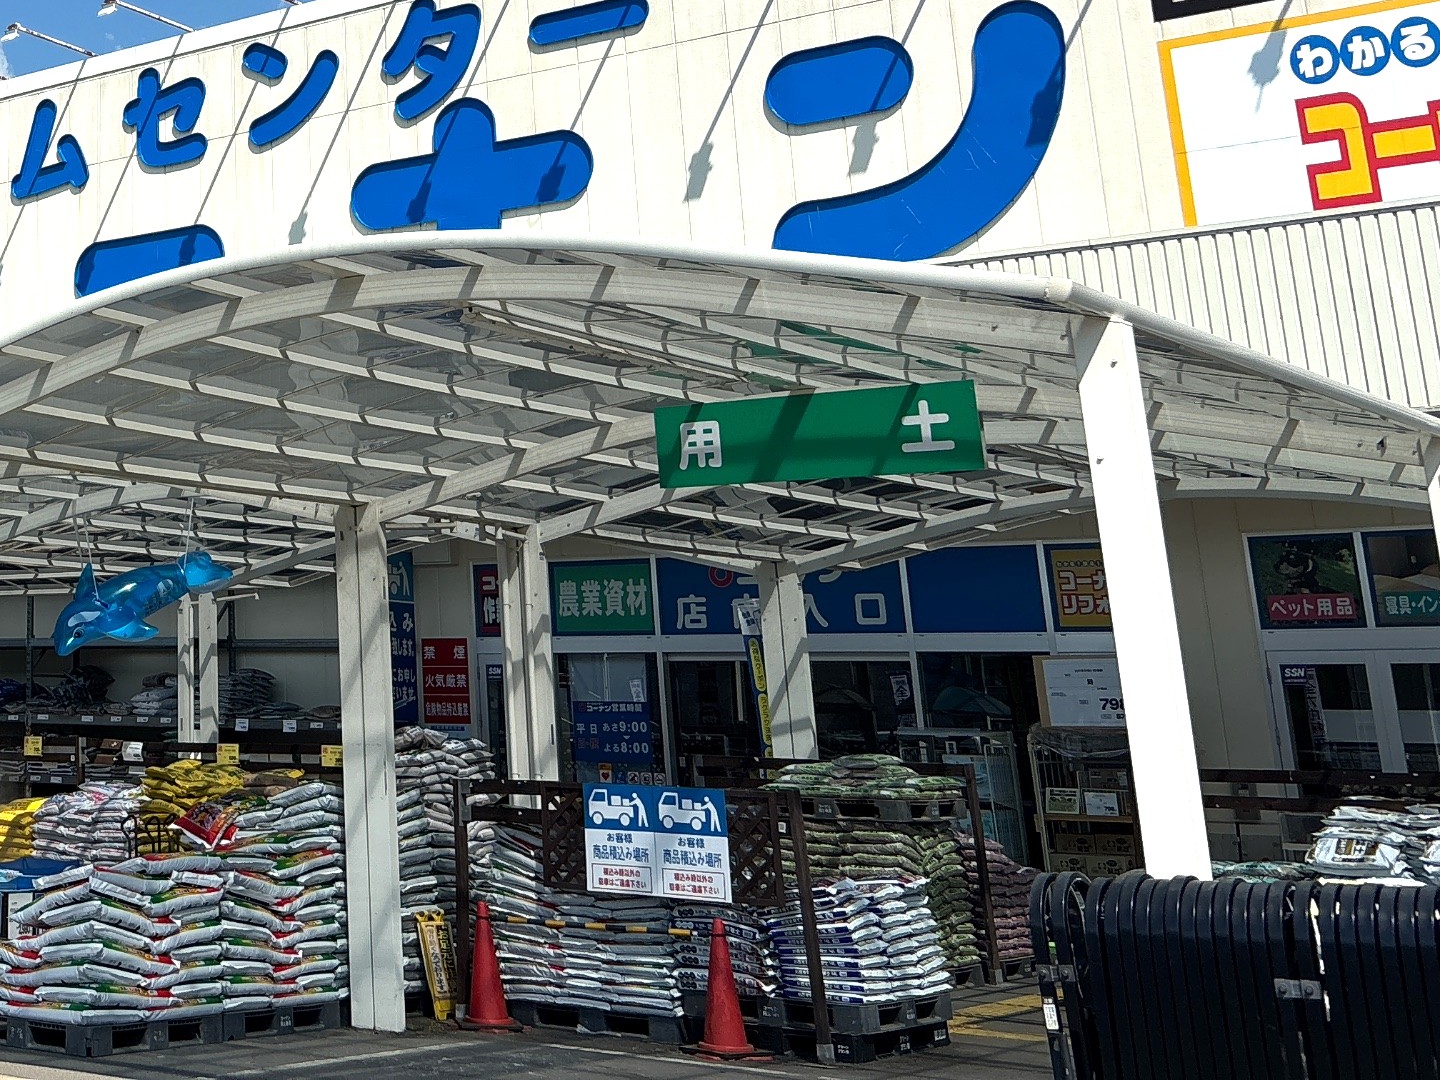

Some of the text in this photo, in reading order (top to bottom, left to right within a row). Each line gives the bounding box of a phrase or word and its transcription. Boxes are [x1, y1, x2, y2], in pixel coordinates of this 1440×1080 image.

[1295, 90, 1440, 211] コー
[680, 400, 955, 470] 用土
[559, 579, 647, 617] 農業資材
[1271, 597, 1353, 617] ペット用品
[1384, 595, 1440, 615] 寝具・イン
[423, 645, 466, 660] 禁煙
[425, 673, 467, 689] 火気厳禁
[1284, 668, 1305, 677] SSN
[576, 723, 598, 735] 平日
[606, 832, 634, 844] お客様
[677, 837, 706, 850] お客様
[593, 844, 649, 863] 商品積込み場所
[663, 848, 723, 869] 商品積込み場所
